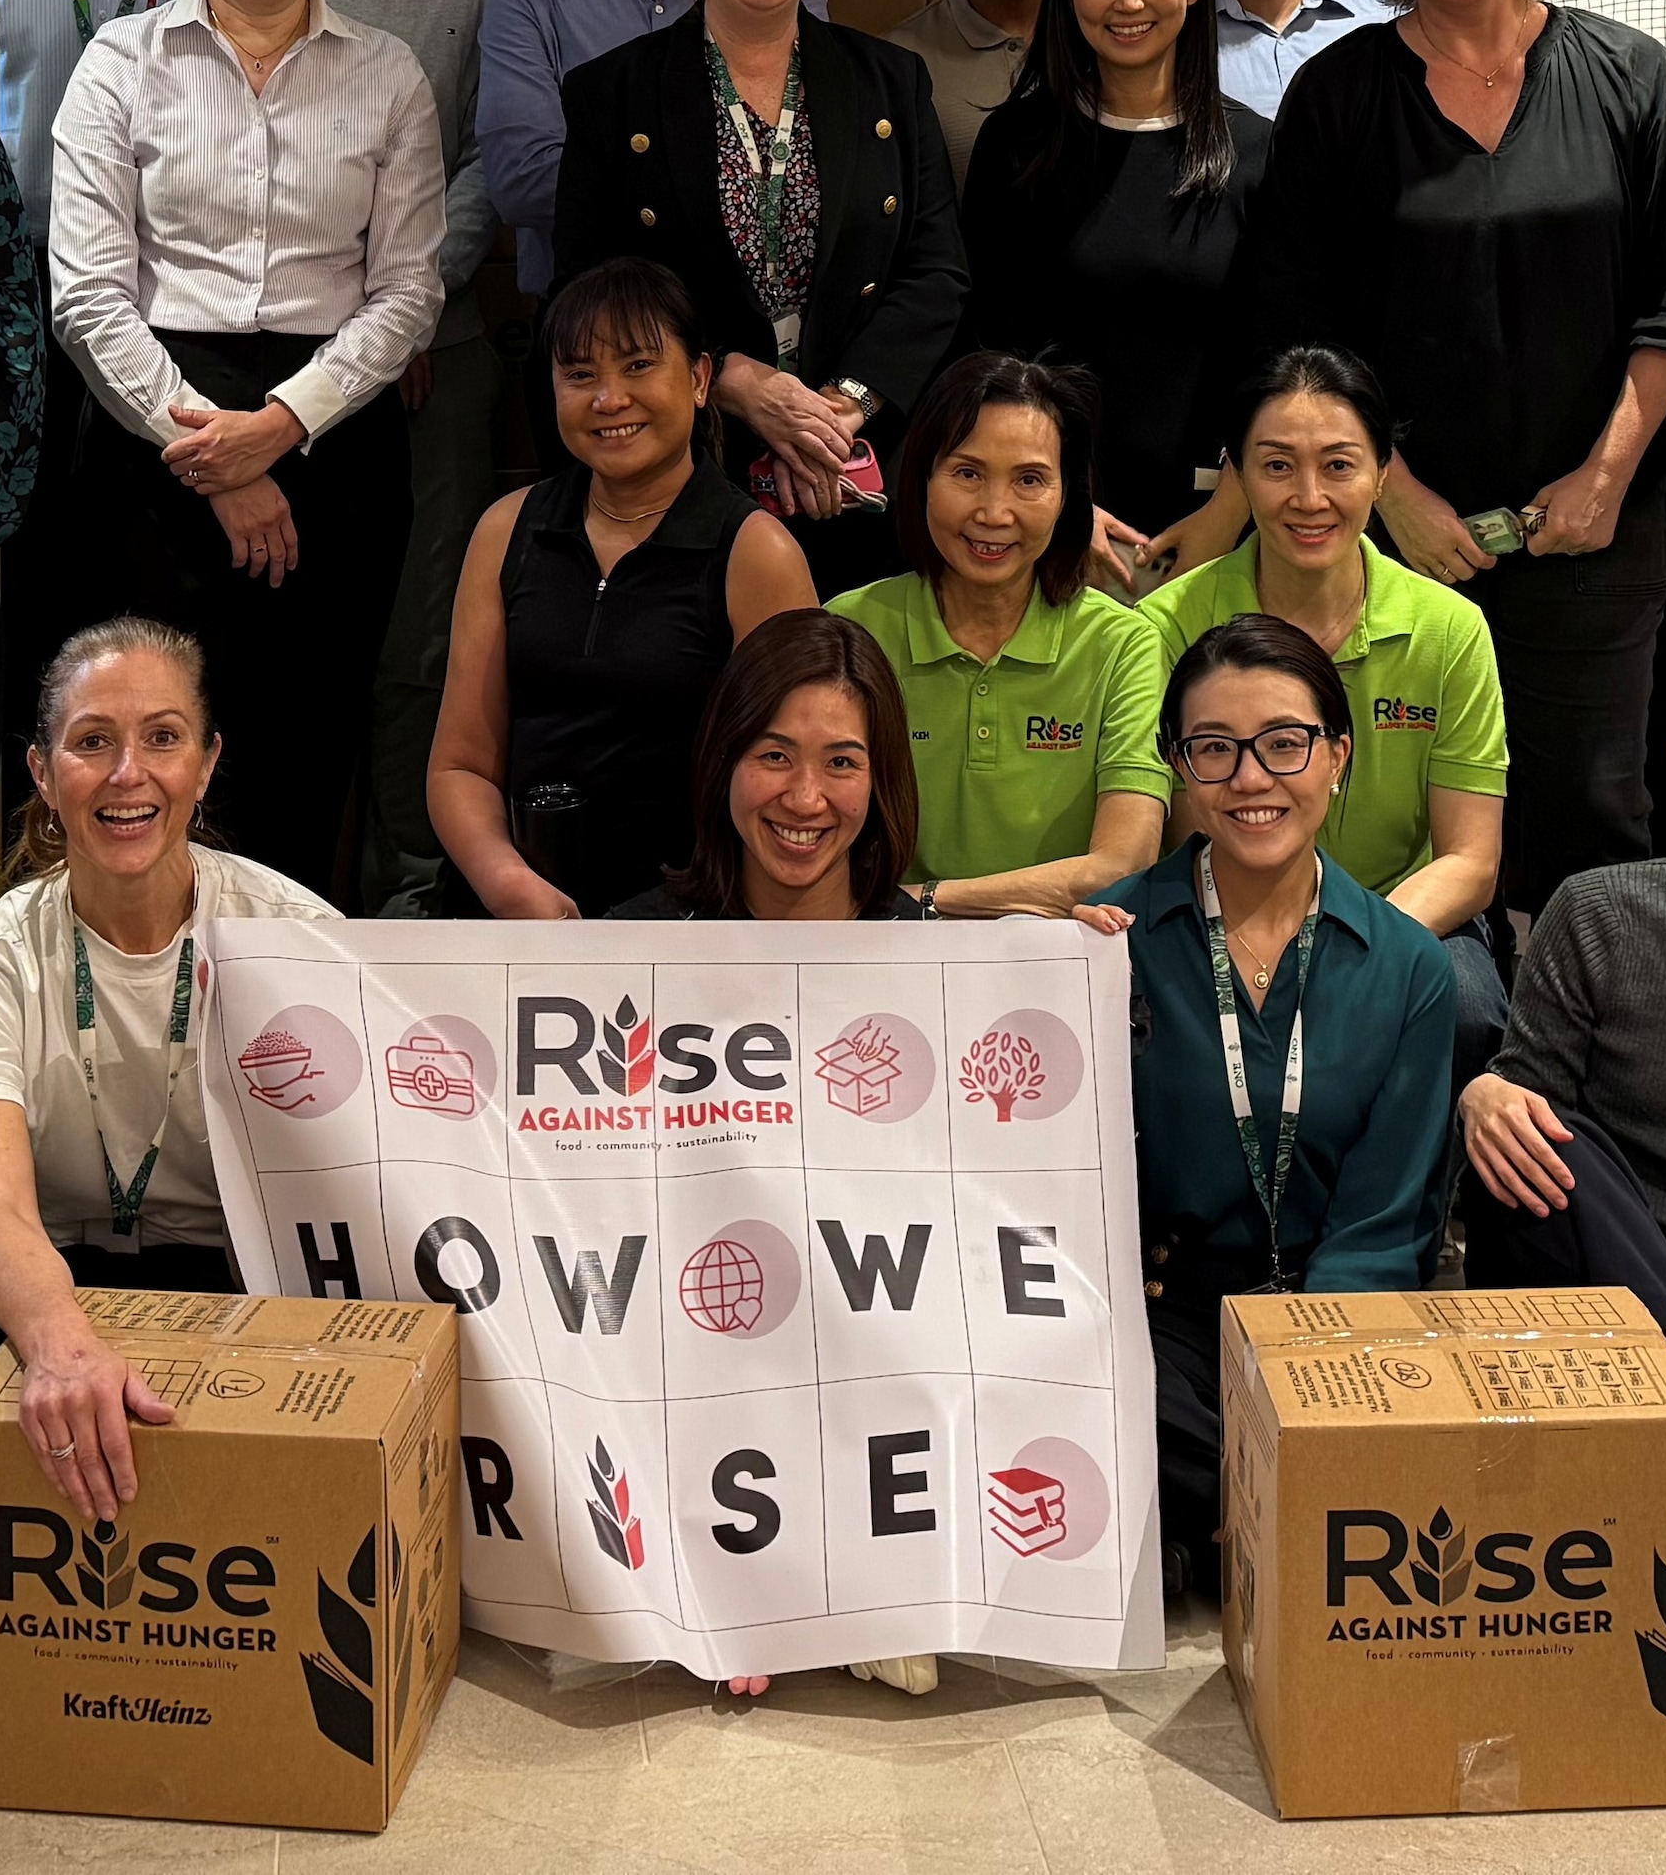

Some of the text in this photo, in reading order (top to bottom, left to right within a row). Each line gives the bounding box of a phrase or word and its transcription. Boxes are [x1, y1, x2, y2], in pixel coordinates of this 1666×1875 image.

[1374, 697, 1437, 723] Rise
[1026, 716, 1083, 741] Rise
[516, 993, 791, 1096] Rise
[1288, 1037, 1298, 1065] ONE
[1232, 1062, 1244, 1089] ONE
[518, 1101, 793, 1131] AGAINST HUNGER
[554, 1131, 758, 1152] food community sustainability
[1326, 1506, 1613, 1607] Rise
[143, 1621, 276, 1652] HUNGER
[1327, 1611, 1612, 1642] AGAINST HUNGER
[33, 1647, 238, 1672] food community sustainability
[1366, 1644, 1575, 1661] food community sustainability
